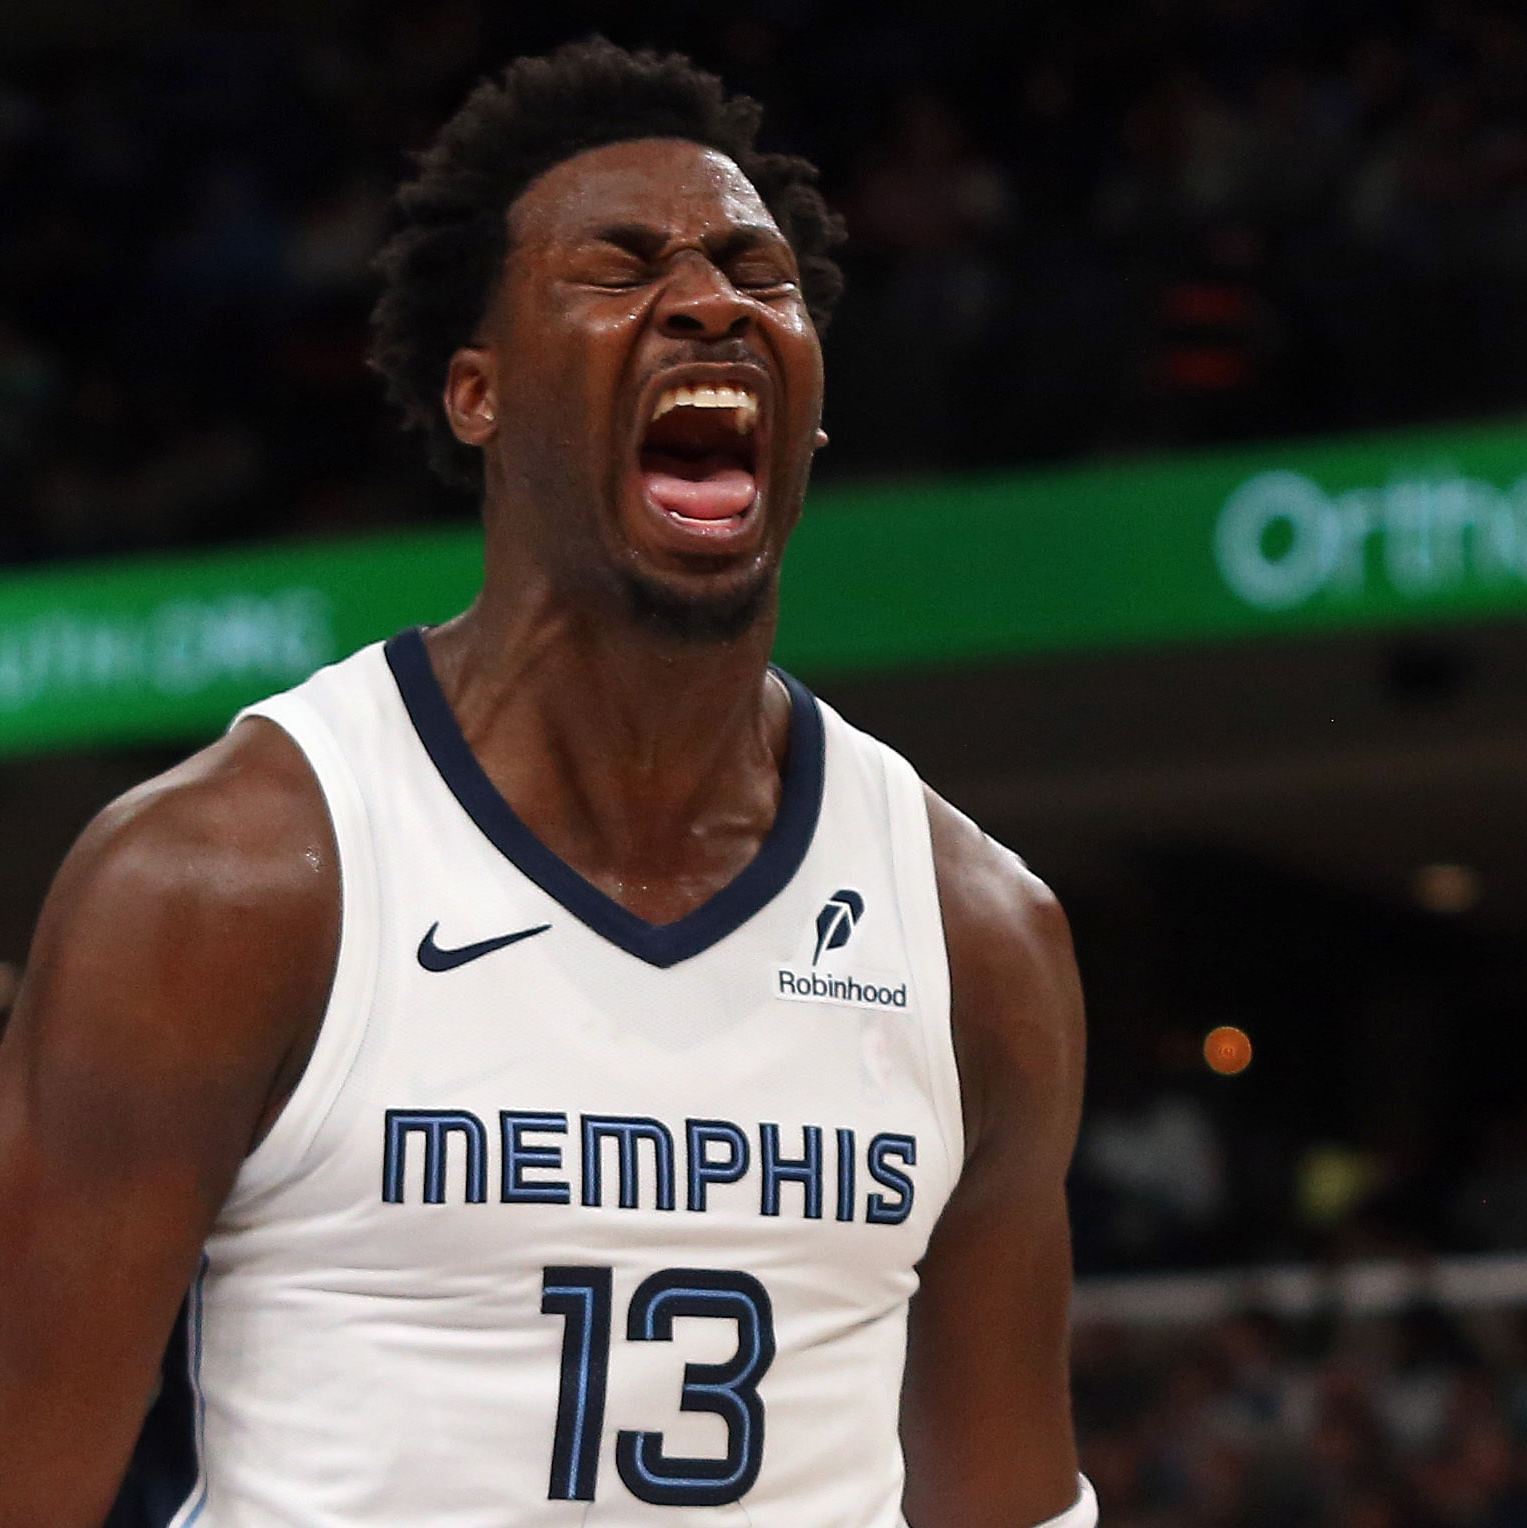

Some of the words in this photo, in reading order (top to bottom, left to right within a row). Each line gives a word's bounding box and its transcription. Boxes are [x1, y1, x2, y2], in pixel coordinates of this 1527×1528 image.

[778, 970, 906, 1007] Robinhood
[382, 1108, 916, 1225] MEMPHIS
[540, 1265, 776, 1507] 13
